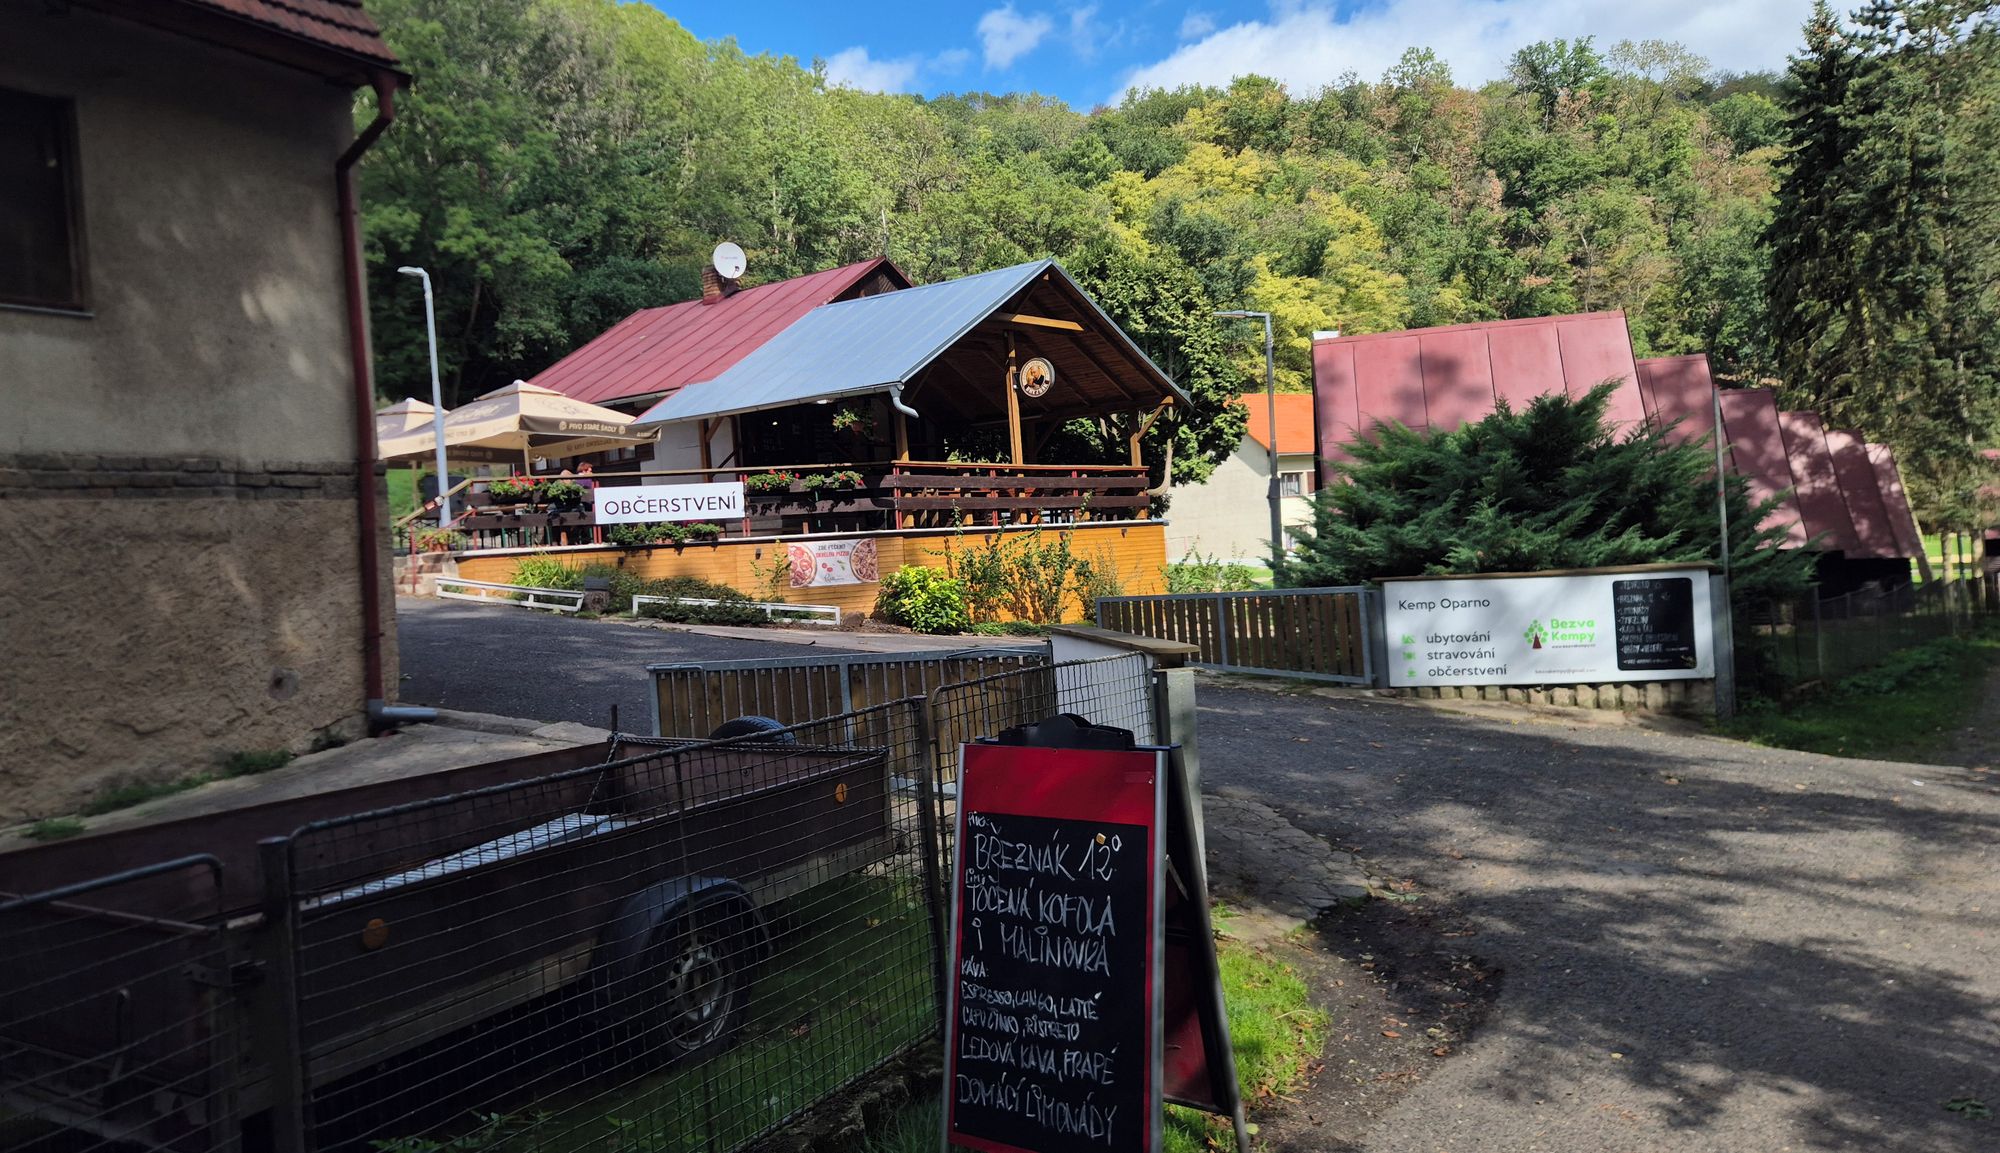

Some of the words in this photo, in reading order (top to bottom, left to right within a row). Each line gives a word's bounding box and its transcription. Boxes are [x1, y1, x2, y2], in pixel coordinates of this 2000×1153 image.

[568, 422, 583, 431] PIVO
[604, 491, 737, 516] OBČERSTVENÍ
[1399, 600, 1436, 612] Kemp
[1440, 598, 1491, 611] Oparno
[1551, 619, 1595, 629] Bezva
[1426, 631, 1491, 646] ubytování
[1551, 631, 1595, 643] Kempy
[1427, 648, 1495, 661] stravování
[1428, 664, 1508, 677] občerstvení
